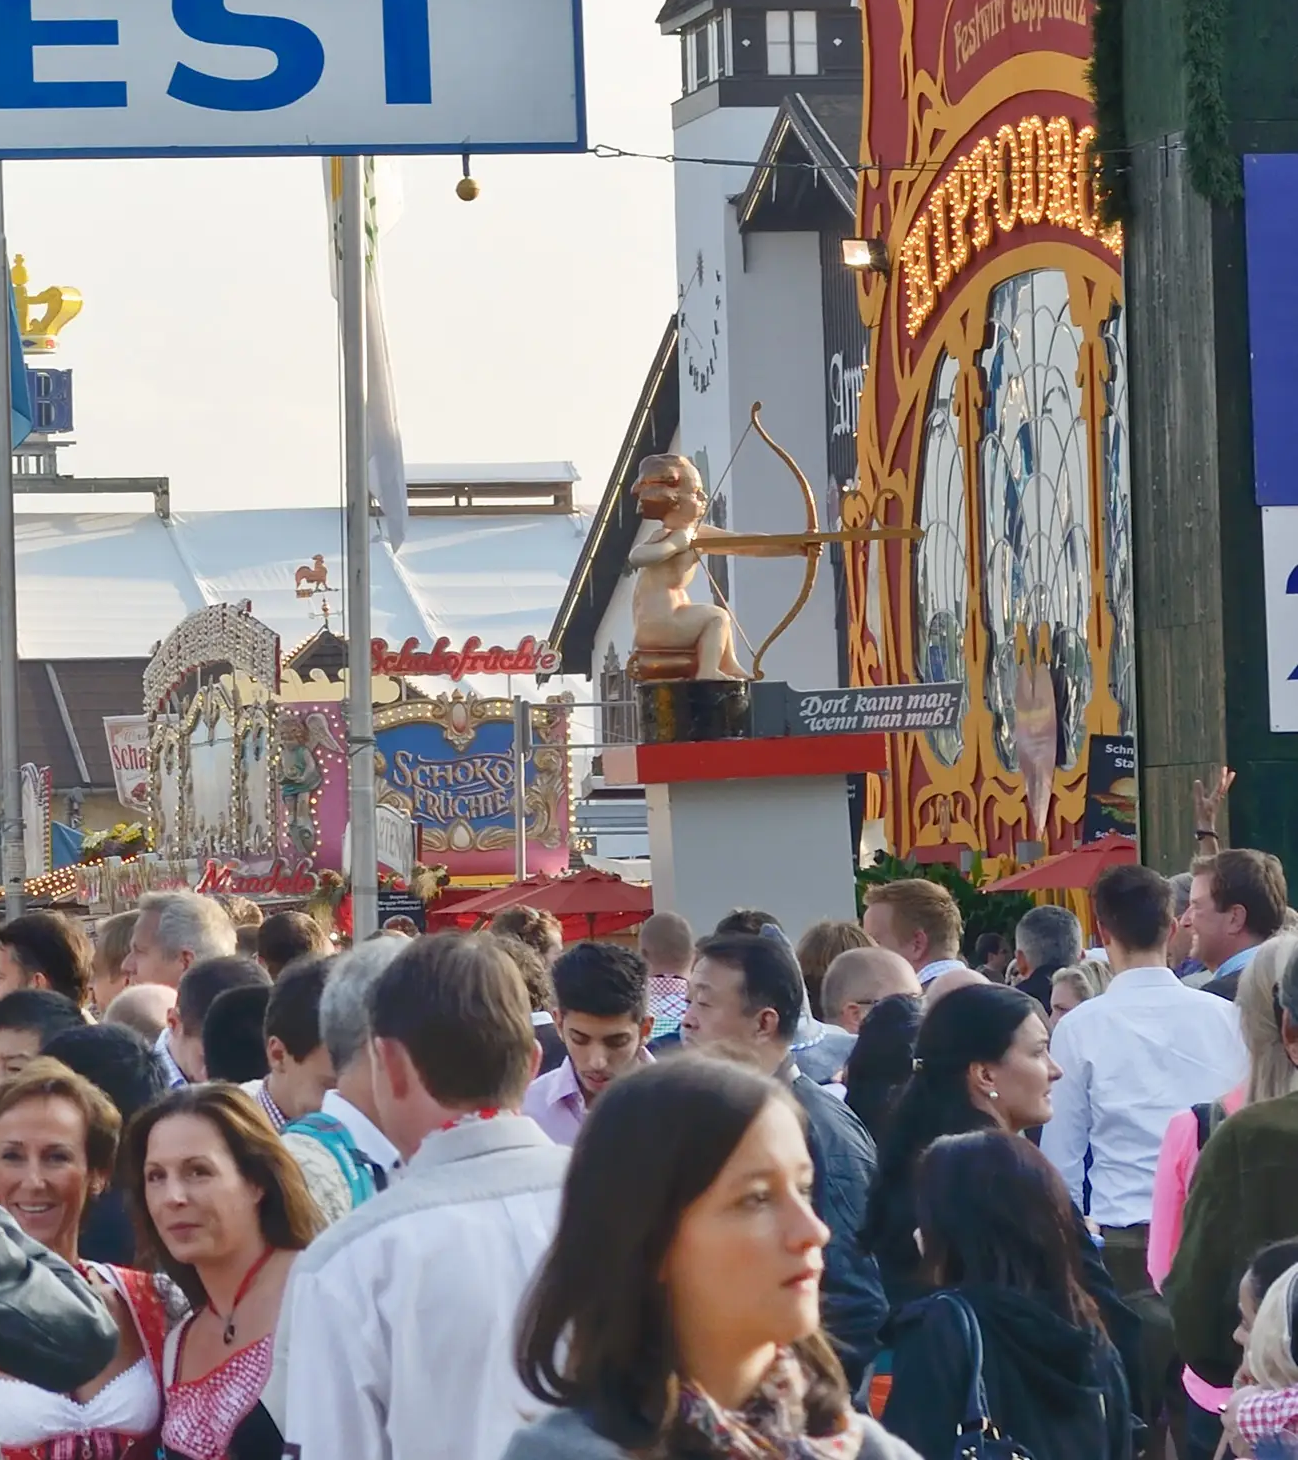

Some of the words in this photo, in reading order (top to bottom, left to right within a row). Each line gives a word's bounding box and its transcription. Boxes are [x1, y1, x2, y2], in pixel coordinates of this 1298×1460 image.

[900, 114, 1123, 339] HIPPODRO
[371, 636, 561, 682] Schokofrüchte
[799, 693, 851, 717] Dort
[854, 694, 904, 713] kann
[907, 692, 959, 710] man-
[804, 715, 858, 732] wenn
[861, 712, 902, 729] man
[905, 707, 955, 726] muß!
[413, 787, 511, 824] FRÜCHTE
